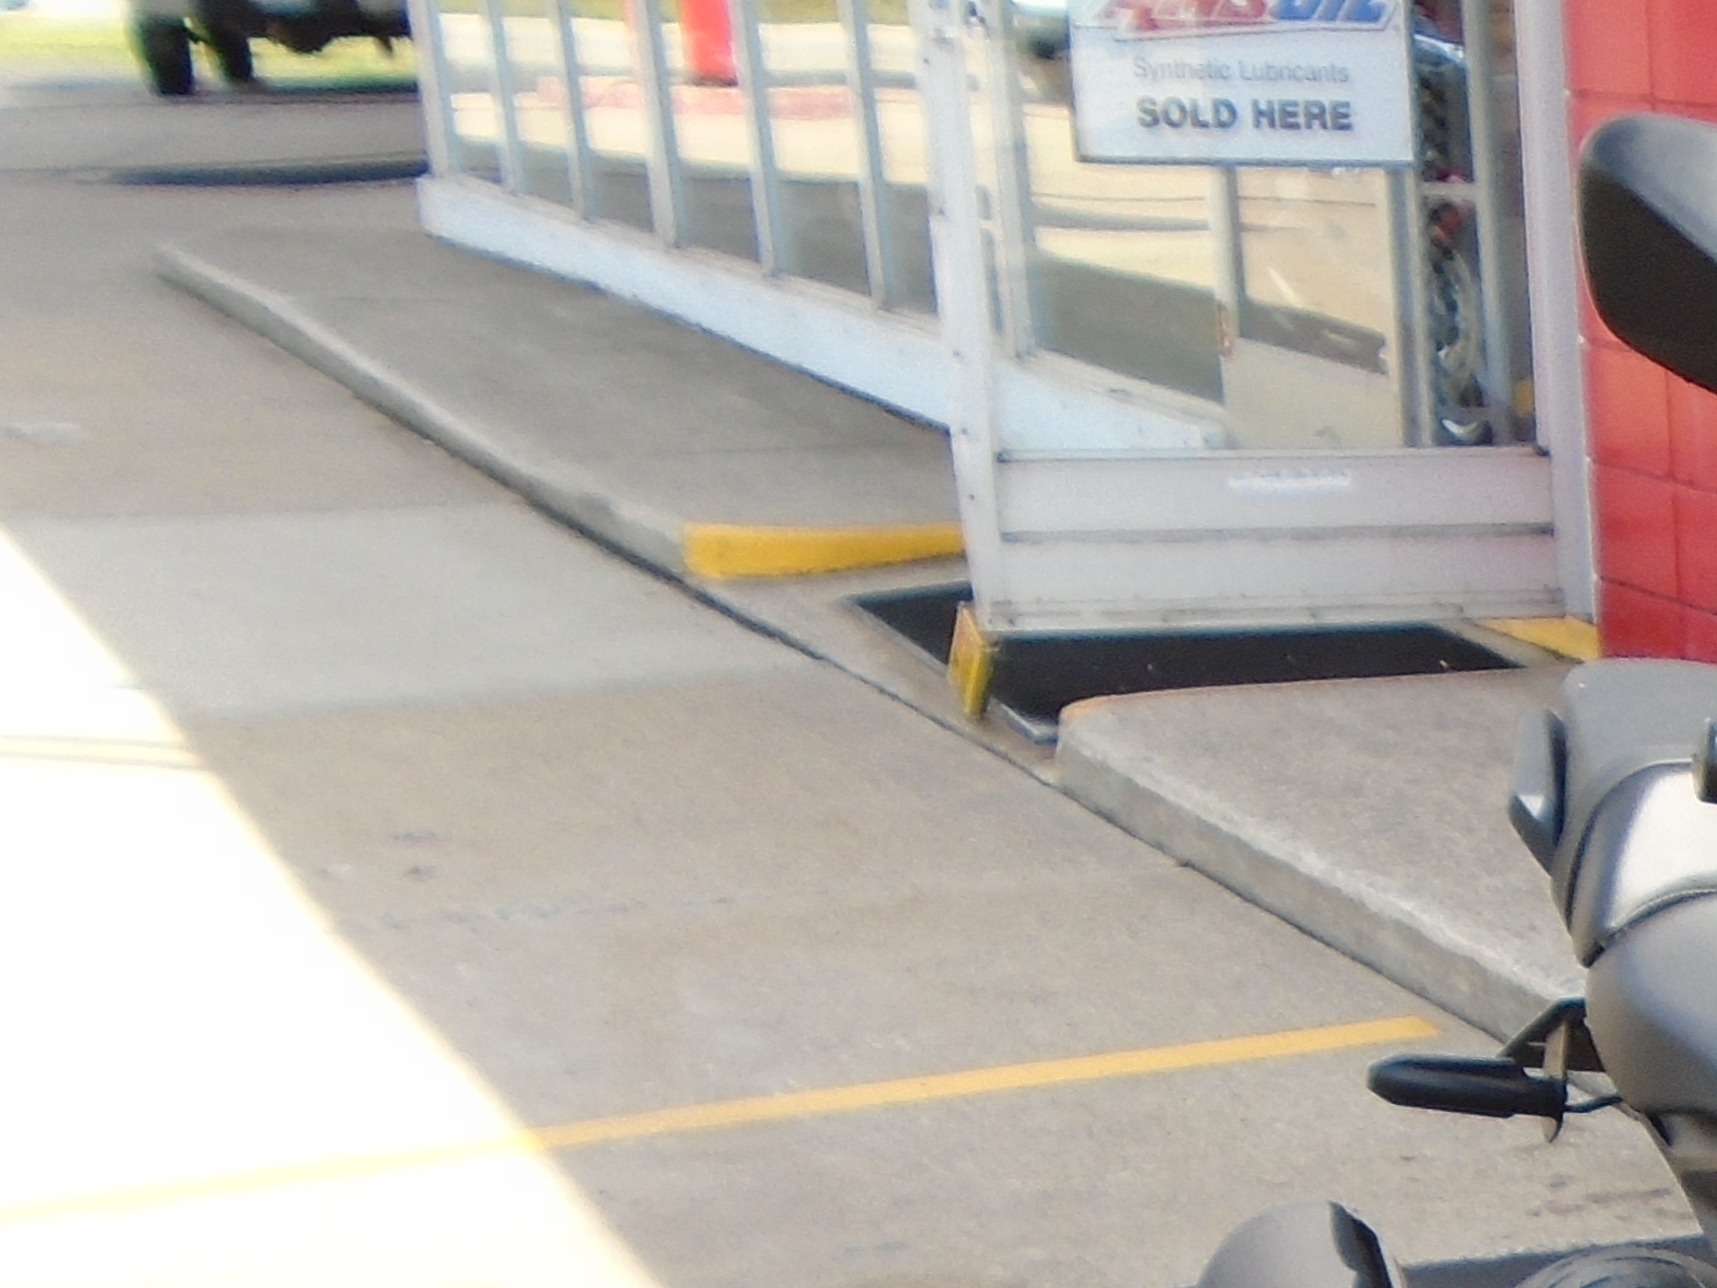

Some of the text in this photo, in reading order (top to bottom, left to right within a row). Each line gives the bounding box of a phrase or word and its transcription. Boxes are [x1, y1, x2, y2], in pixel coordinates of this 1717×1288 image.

[1133, 57, 1349, 83] Synthetic Lubricants
[1137, 97, 1354, 131] SOLD HERE
